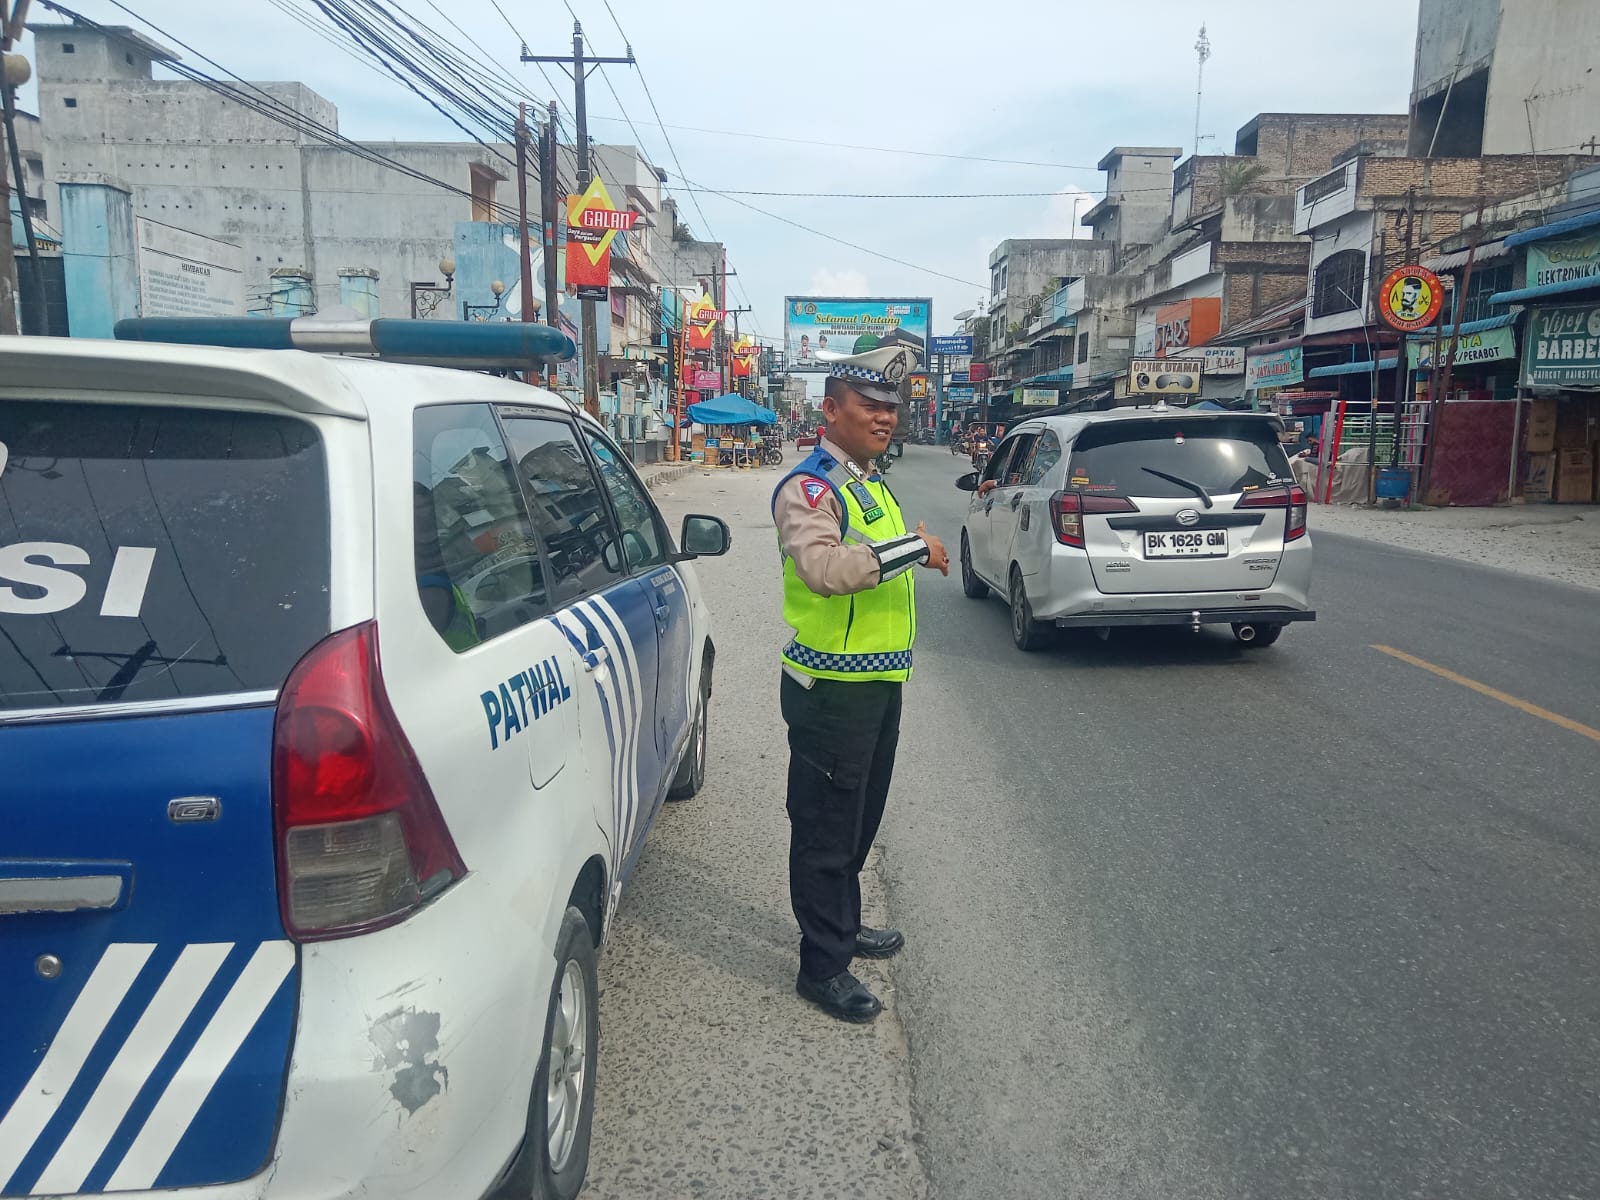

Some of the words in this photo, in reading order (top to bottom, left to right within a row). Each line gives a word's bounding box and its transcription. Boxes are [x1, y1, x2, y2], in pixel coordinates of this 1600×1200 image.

[584, 210, 630, 229] GALAN
[1537, 263, 1600, 286] ELEKTRONIK/
[698, 310, 724, 321] GALAN
[815, 313, 858, 324] Selamat
[860, 313, 901, 326] Datang
[672, 337, 680, 376] RAZOR
[1536, 339, 1600, 360] BARBE
[1133, 362, 1163, 372] OPTIK
[1165, 362, 1199, 373] UTAMA
[1566, 368, 1600, 379] HAIRSTYL
[1148, 535, 1166, 548] BK
[1170, 533, 1203, 547] 1626
[1207, 532, 1225, 546] GM
[480, 656, 571, 751] PATWAL
